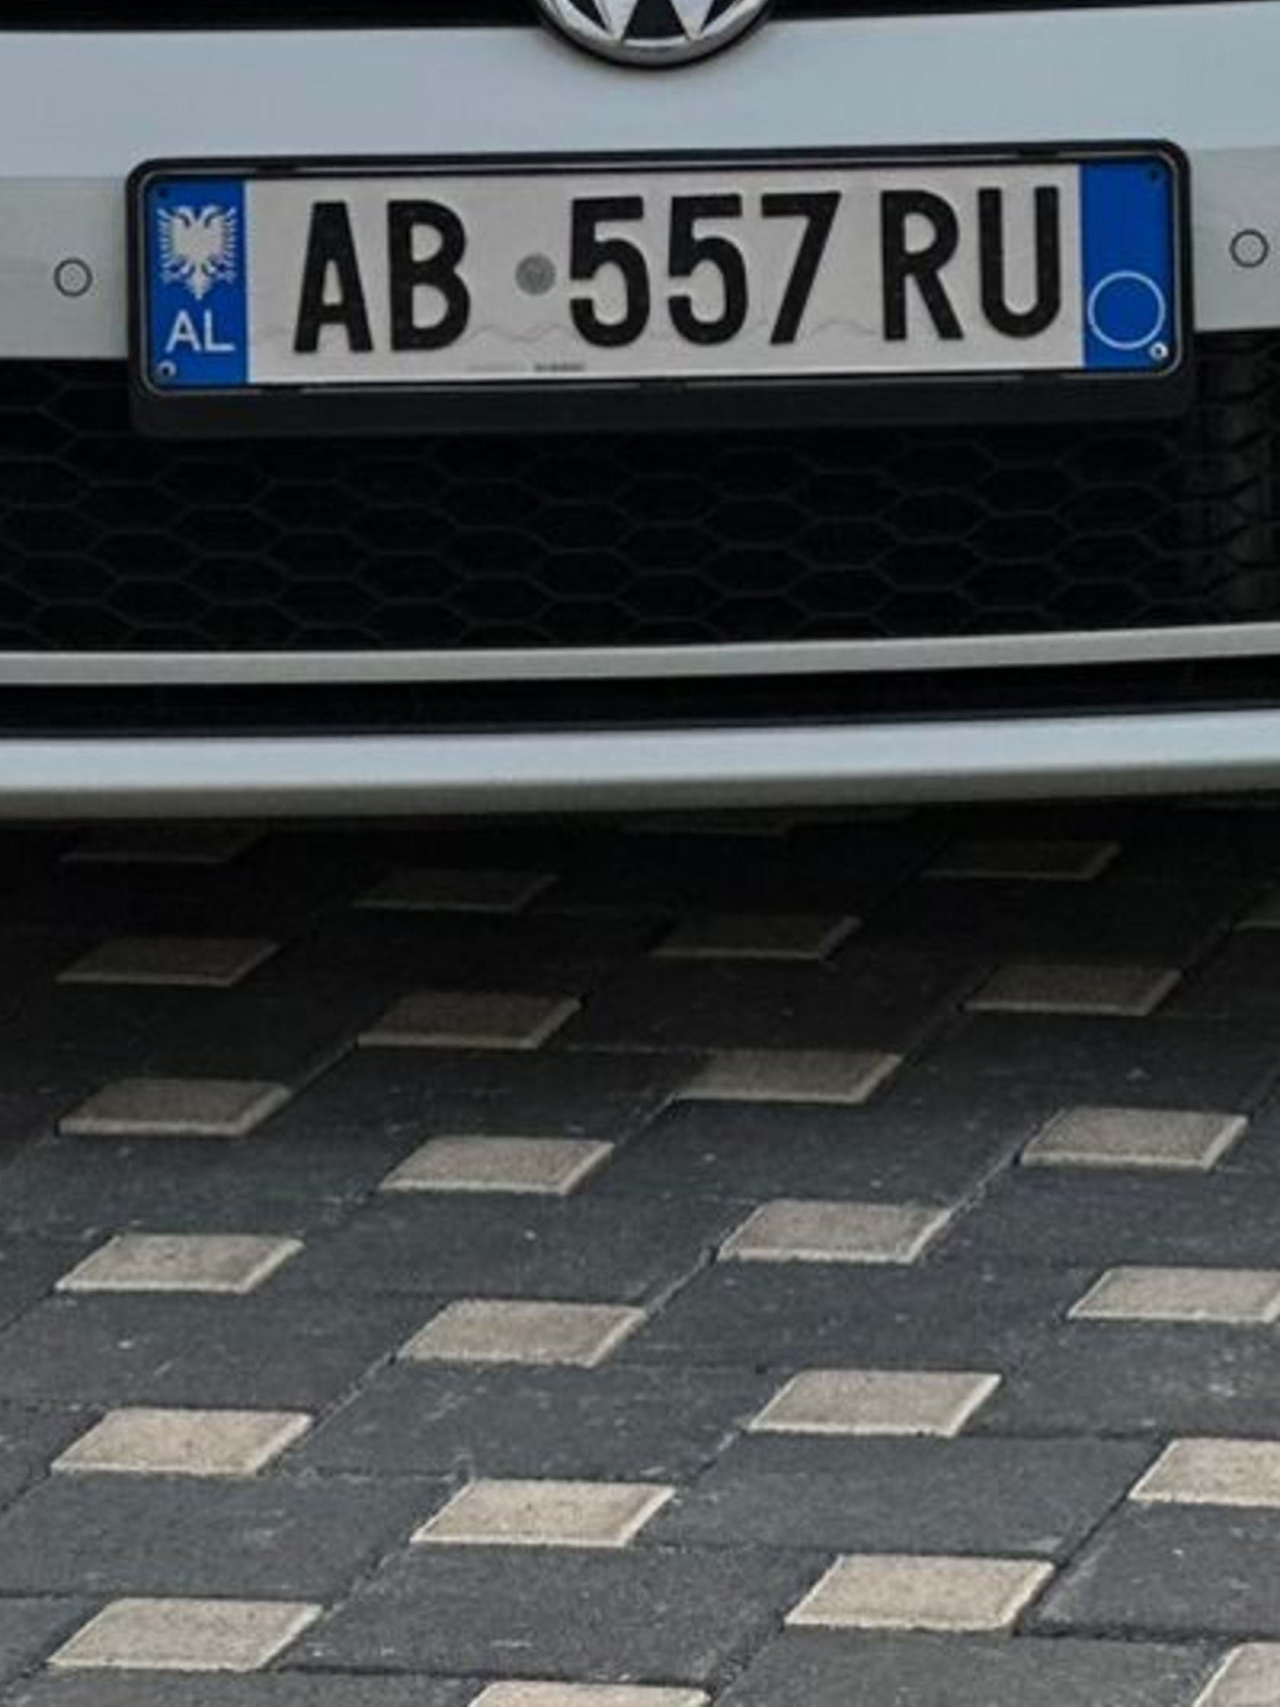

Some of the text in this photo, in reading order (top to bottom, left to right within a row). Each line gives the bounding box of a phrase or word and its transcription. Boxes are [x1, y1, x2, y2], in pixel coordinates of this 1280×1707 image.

[293, 187, 1061, 352] AB 557 RU
[166, 310, 235, 352] AL
